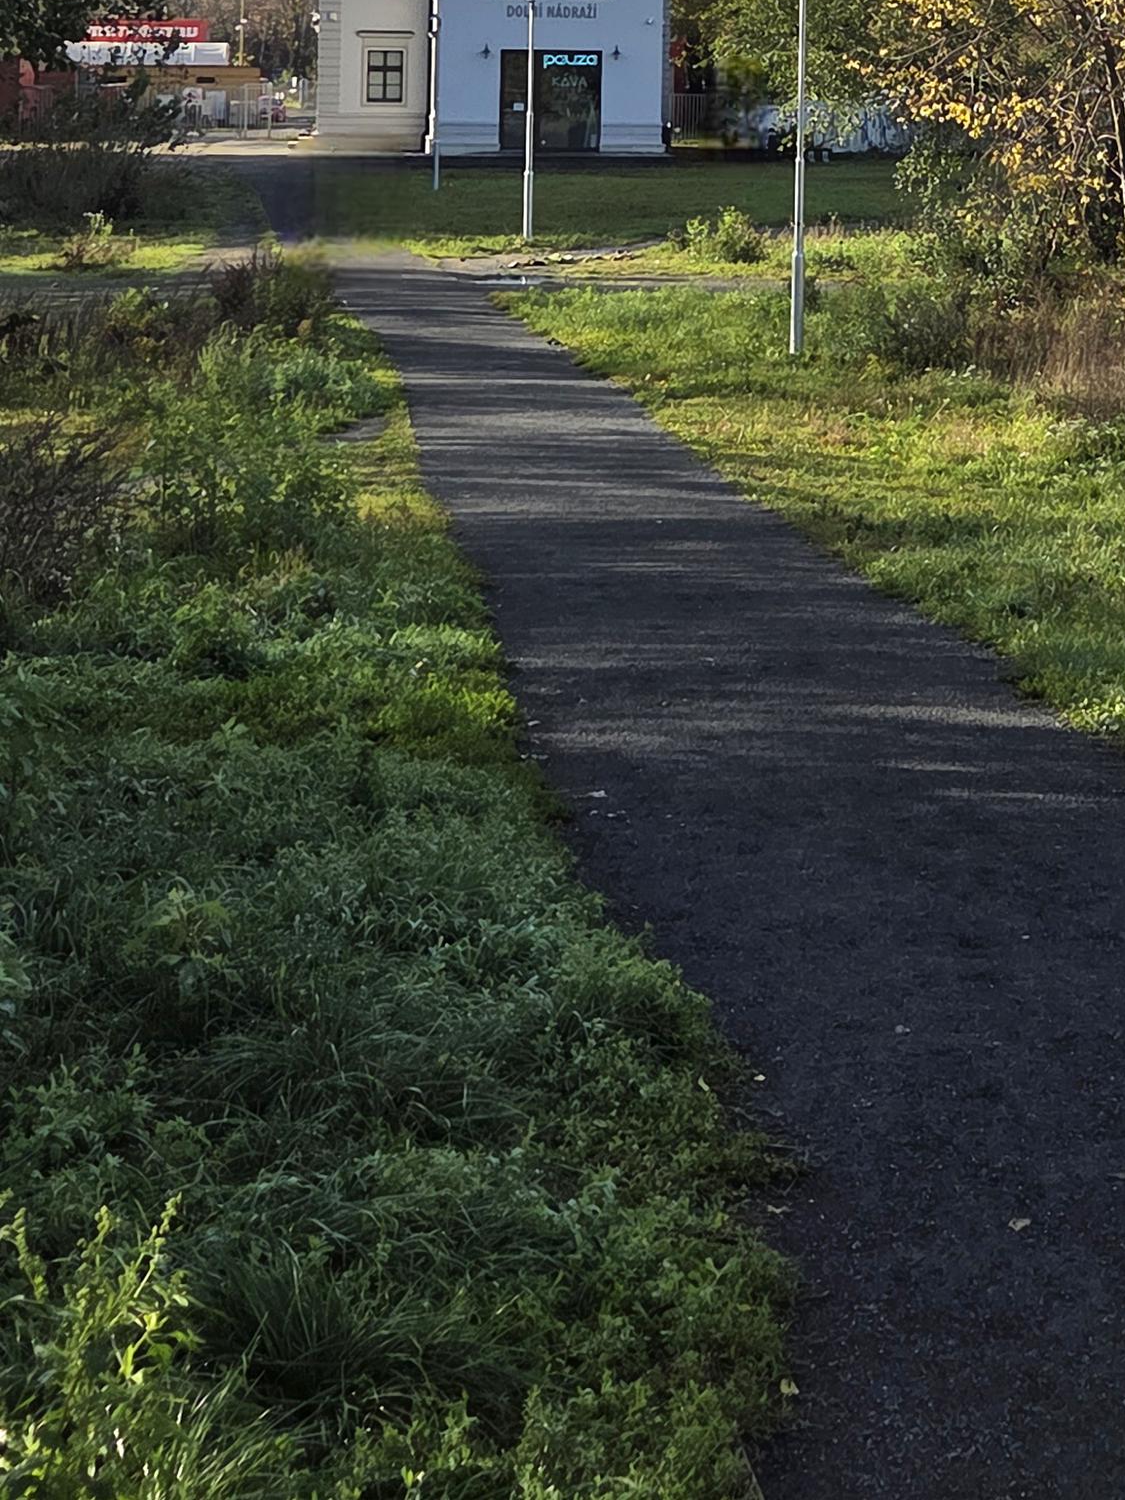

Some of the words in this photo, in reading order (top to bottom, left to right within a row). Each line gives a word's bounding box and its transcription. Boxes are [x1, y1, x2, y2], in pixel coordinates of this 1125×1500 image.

[546, 2, 598, 19] NÁDRAŽÍ
[543, 54, 598, 69] pauza
[551, 71, 588, 88] KÁVA
